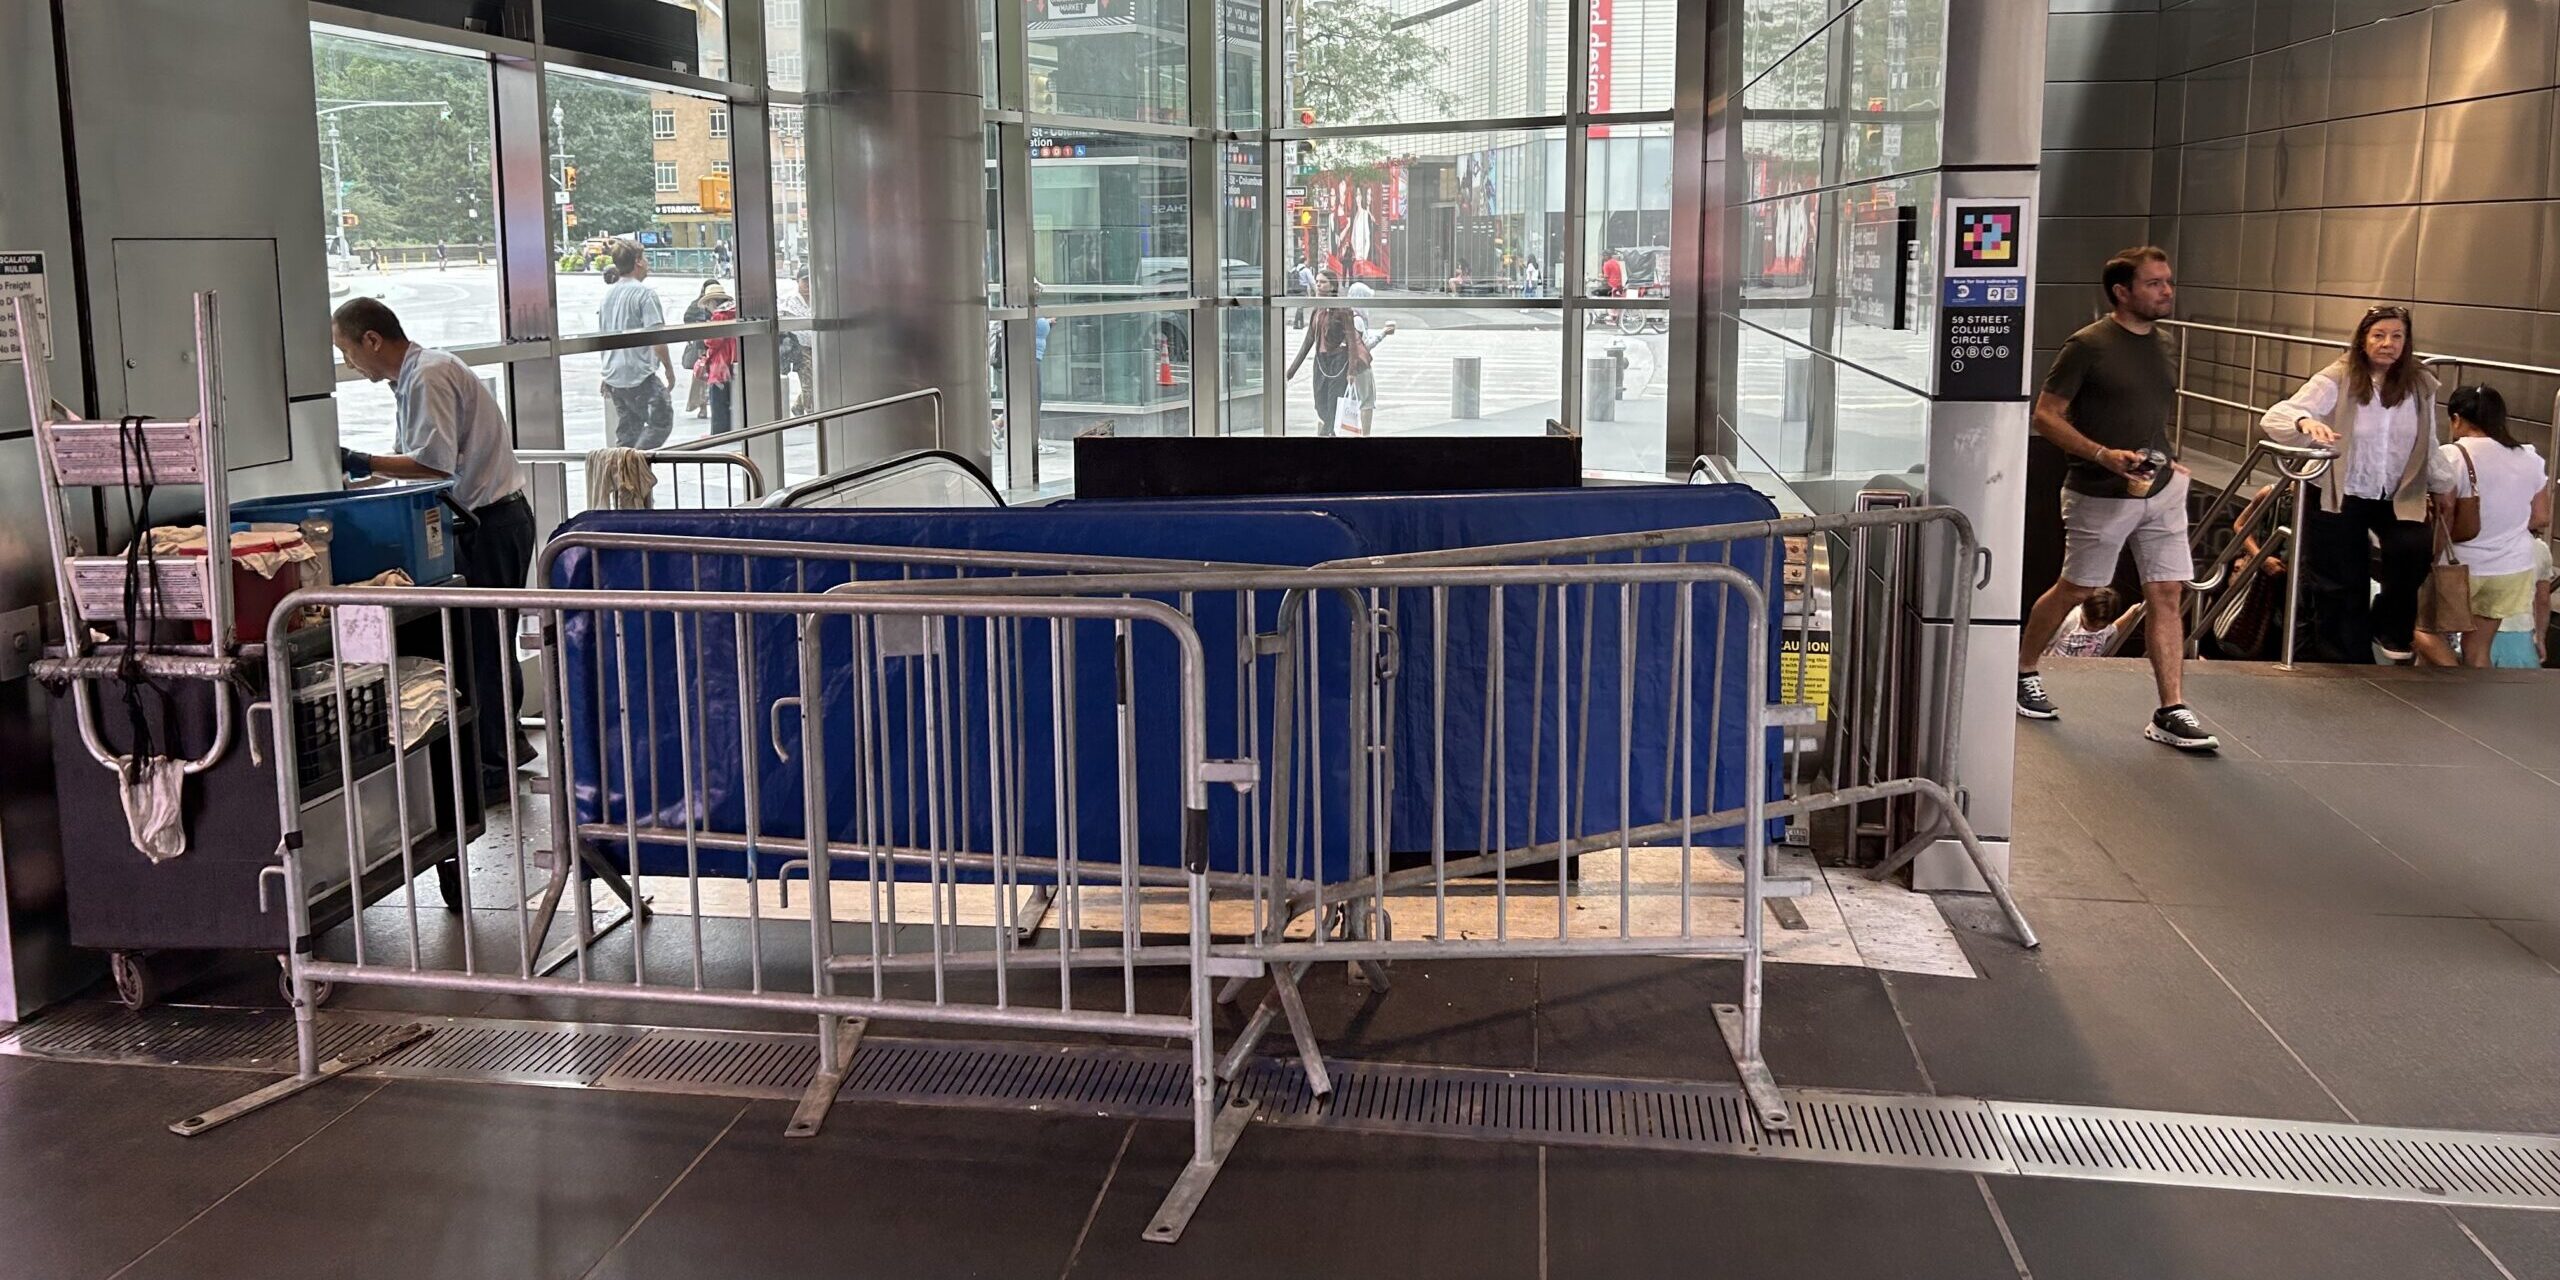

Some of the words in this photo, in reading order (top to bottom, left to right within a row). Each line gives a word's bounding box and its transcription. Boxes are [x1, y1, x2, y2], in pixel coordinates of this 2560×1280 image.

[1591, 0, 1607, 25] nd
[1031, 127, 1043, 137] St
[1030, 137, 1053, 147] ation
[0, 256, 37, 264] SCALATOR
[4, 265, 29, 273] RULES
[5, 281, 31, 292] Freight
[1951, 316, 1964, 324] 59
[1967, 315, 2012, 324] STREET-
[1951, 325, 2010, 334] COLUMBUS
[1951, 335, 1990, 344] CIRCLE
[1781, 641, 1829, 652] AUION
